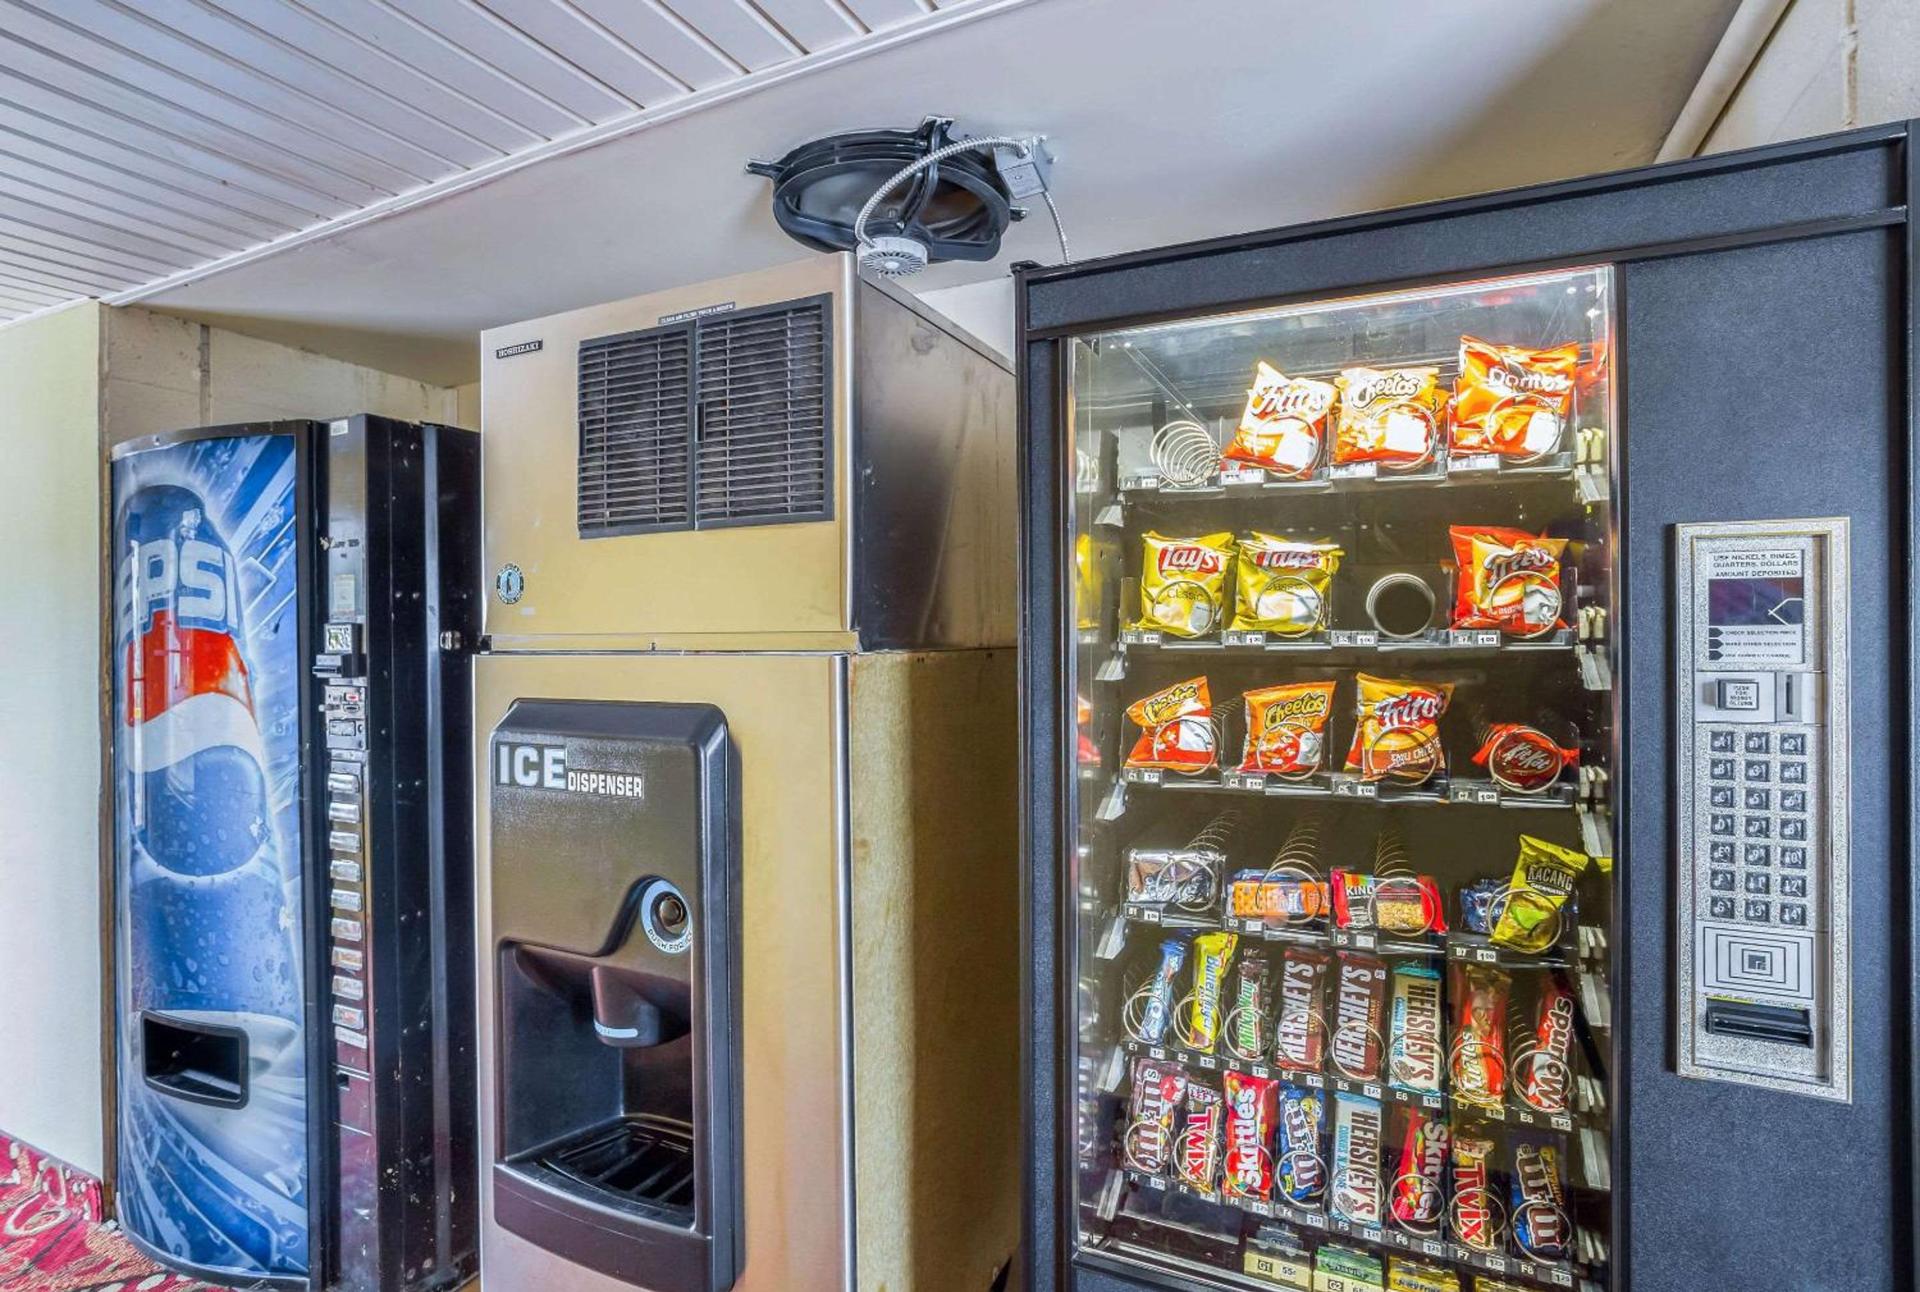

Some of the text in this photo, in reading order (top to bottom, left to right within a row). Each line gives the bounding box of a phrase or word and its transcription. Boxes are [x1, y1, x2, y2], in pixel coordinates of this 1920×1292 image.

[1352, 372, 1421, 409] Cheetos
[1264, 693, 1328, 730] Cheetos
[498, 744, 643, 798] ICE DISPENSER
[1335, 965, 1372, 1070] HERSHEY'S
[1406, 984, 1437, 1081] HERSHEY'S
[1337, 1080, 1349, 1091] E5
[1396, 1091, 1408, 1101] E6
[1234, 1088, 1262, 1188] Skittles
[1349, 1110, 1379, 1216] HERSHEY'S
[1457, 1250, 1470, 1260] F7
[1521, 1263, 1534, 1274] F8
[1329, 1280, 1343, 1291] G2
